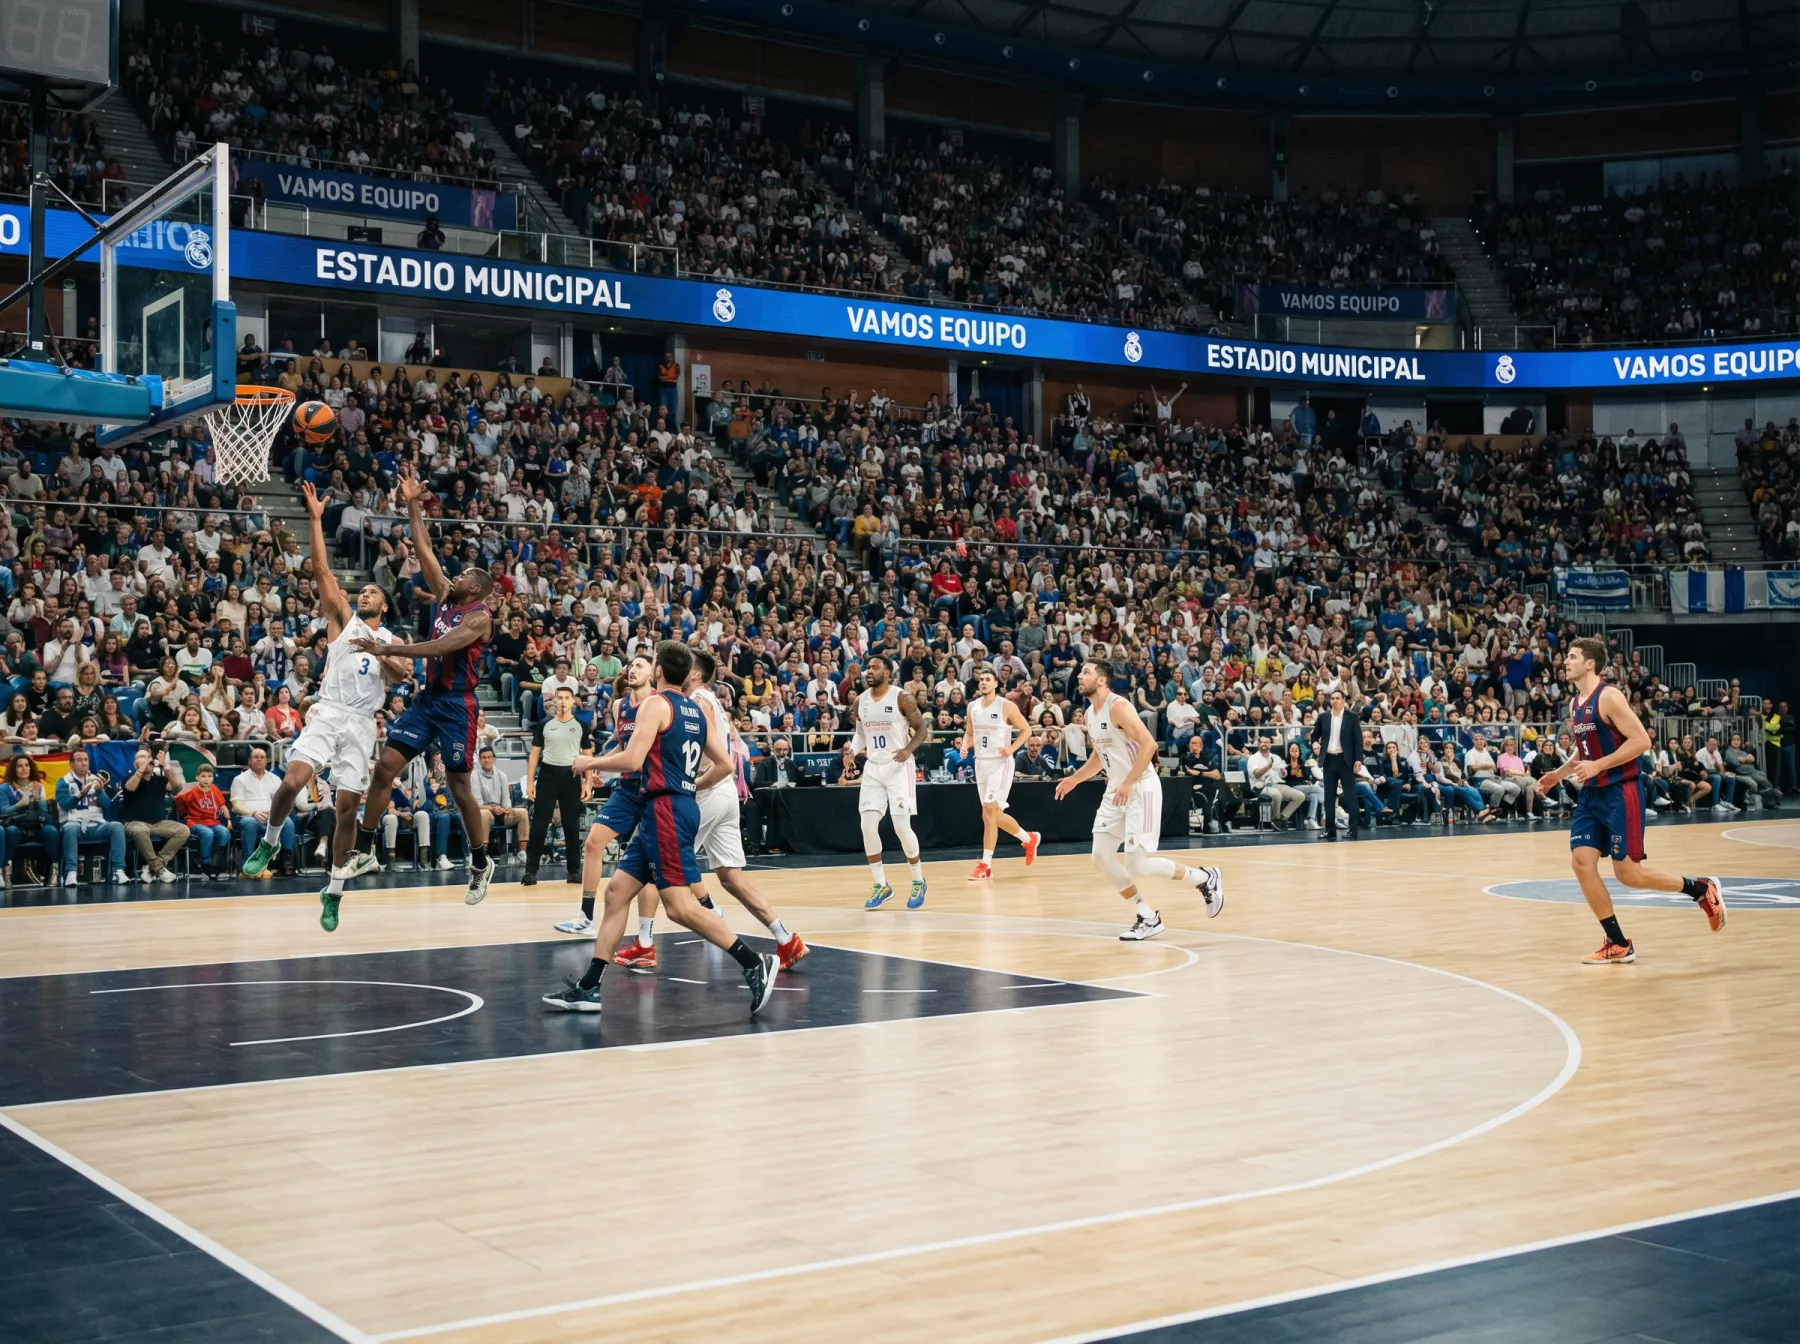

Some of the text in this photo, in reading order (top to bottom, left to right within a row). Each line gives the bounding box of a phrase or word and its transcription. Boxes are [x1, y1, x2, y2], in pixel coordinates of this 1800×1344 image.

[278, 174, 440, 214] VAMOS EQUIPO
[316, 248, 632, 311] ESTADIO MUNICIPAL
[1280, 292, 1400, 314] VAMOS EQUIPO
[846, 306, 1028, 350] VAMOS EQUIPO
[1207, 343, 1427, 381] ESTADIO MUNICIPAL
[1613, 354, 1706, 380] VAMOS
[358, 658, 371, 675] 3
[682, 739, 701, 778] 12
[872, 735, 887, 749] 10
